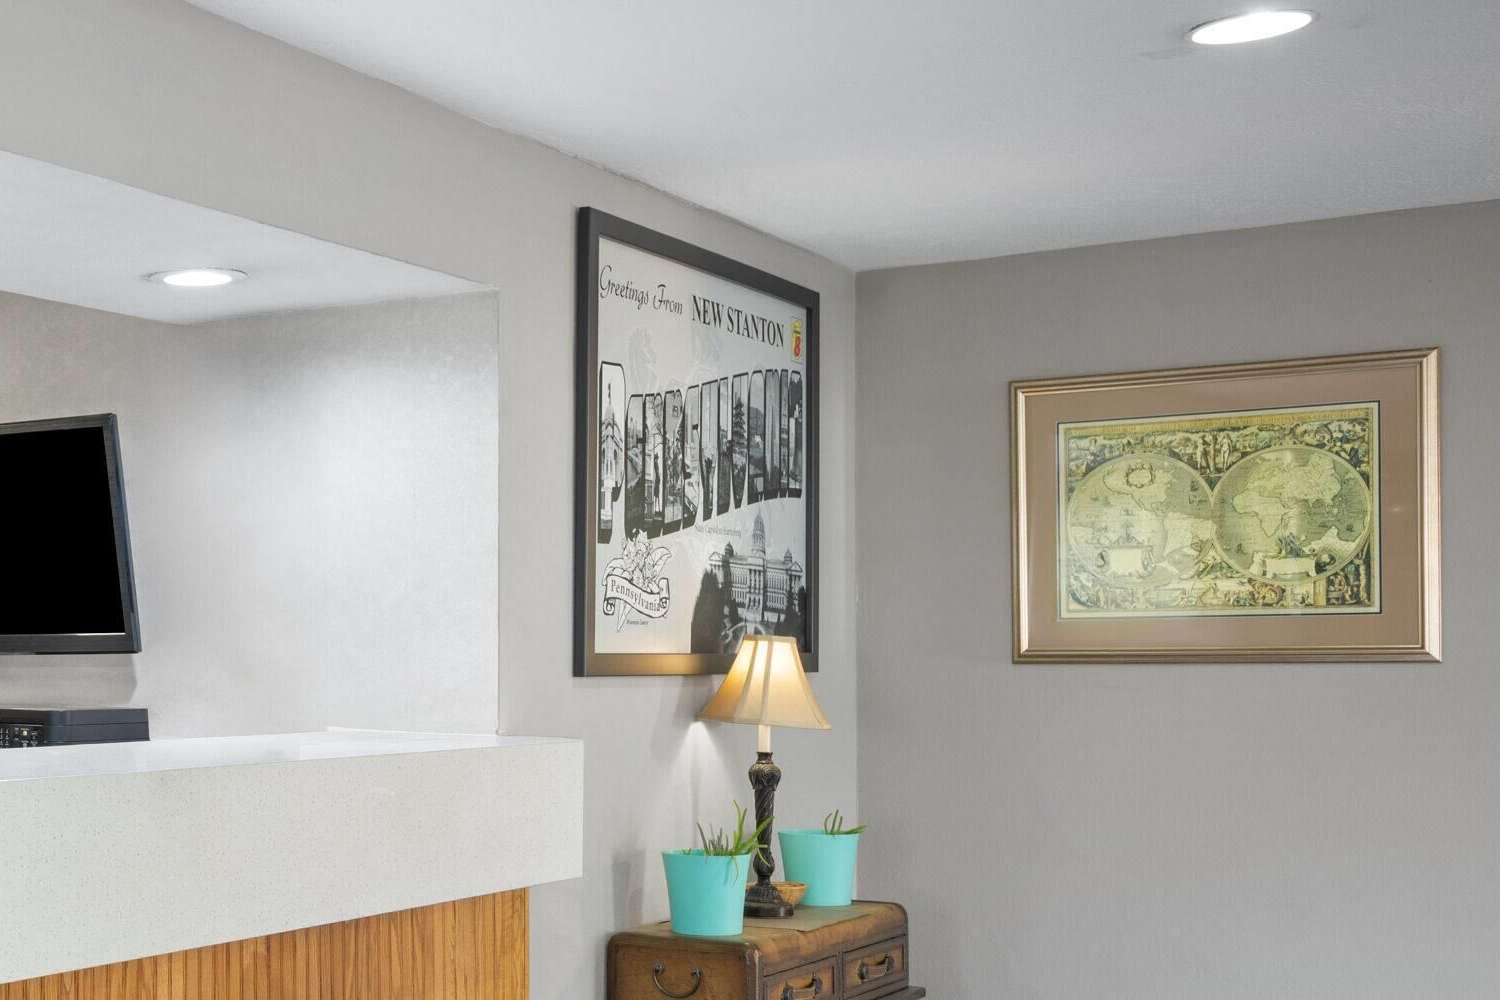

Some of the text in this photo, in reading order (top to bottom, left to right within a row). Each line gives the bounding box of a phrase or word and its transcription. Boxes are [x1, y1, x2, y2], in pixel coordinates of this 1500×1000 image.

[600, 264, 785, 348] Greetings From NEW STANTON
[793, 334, 801, 358] 8
[611, 580, 660, 612] Pennsylvania
